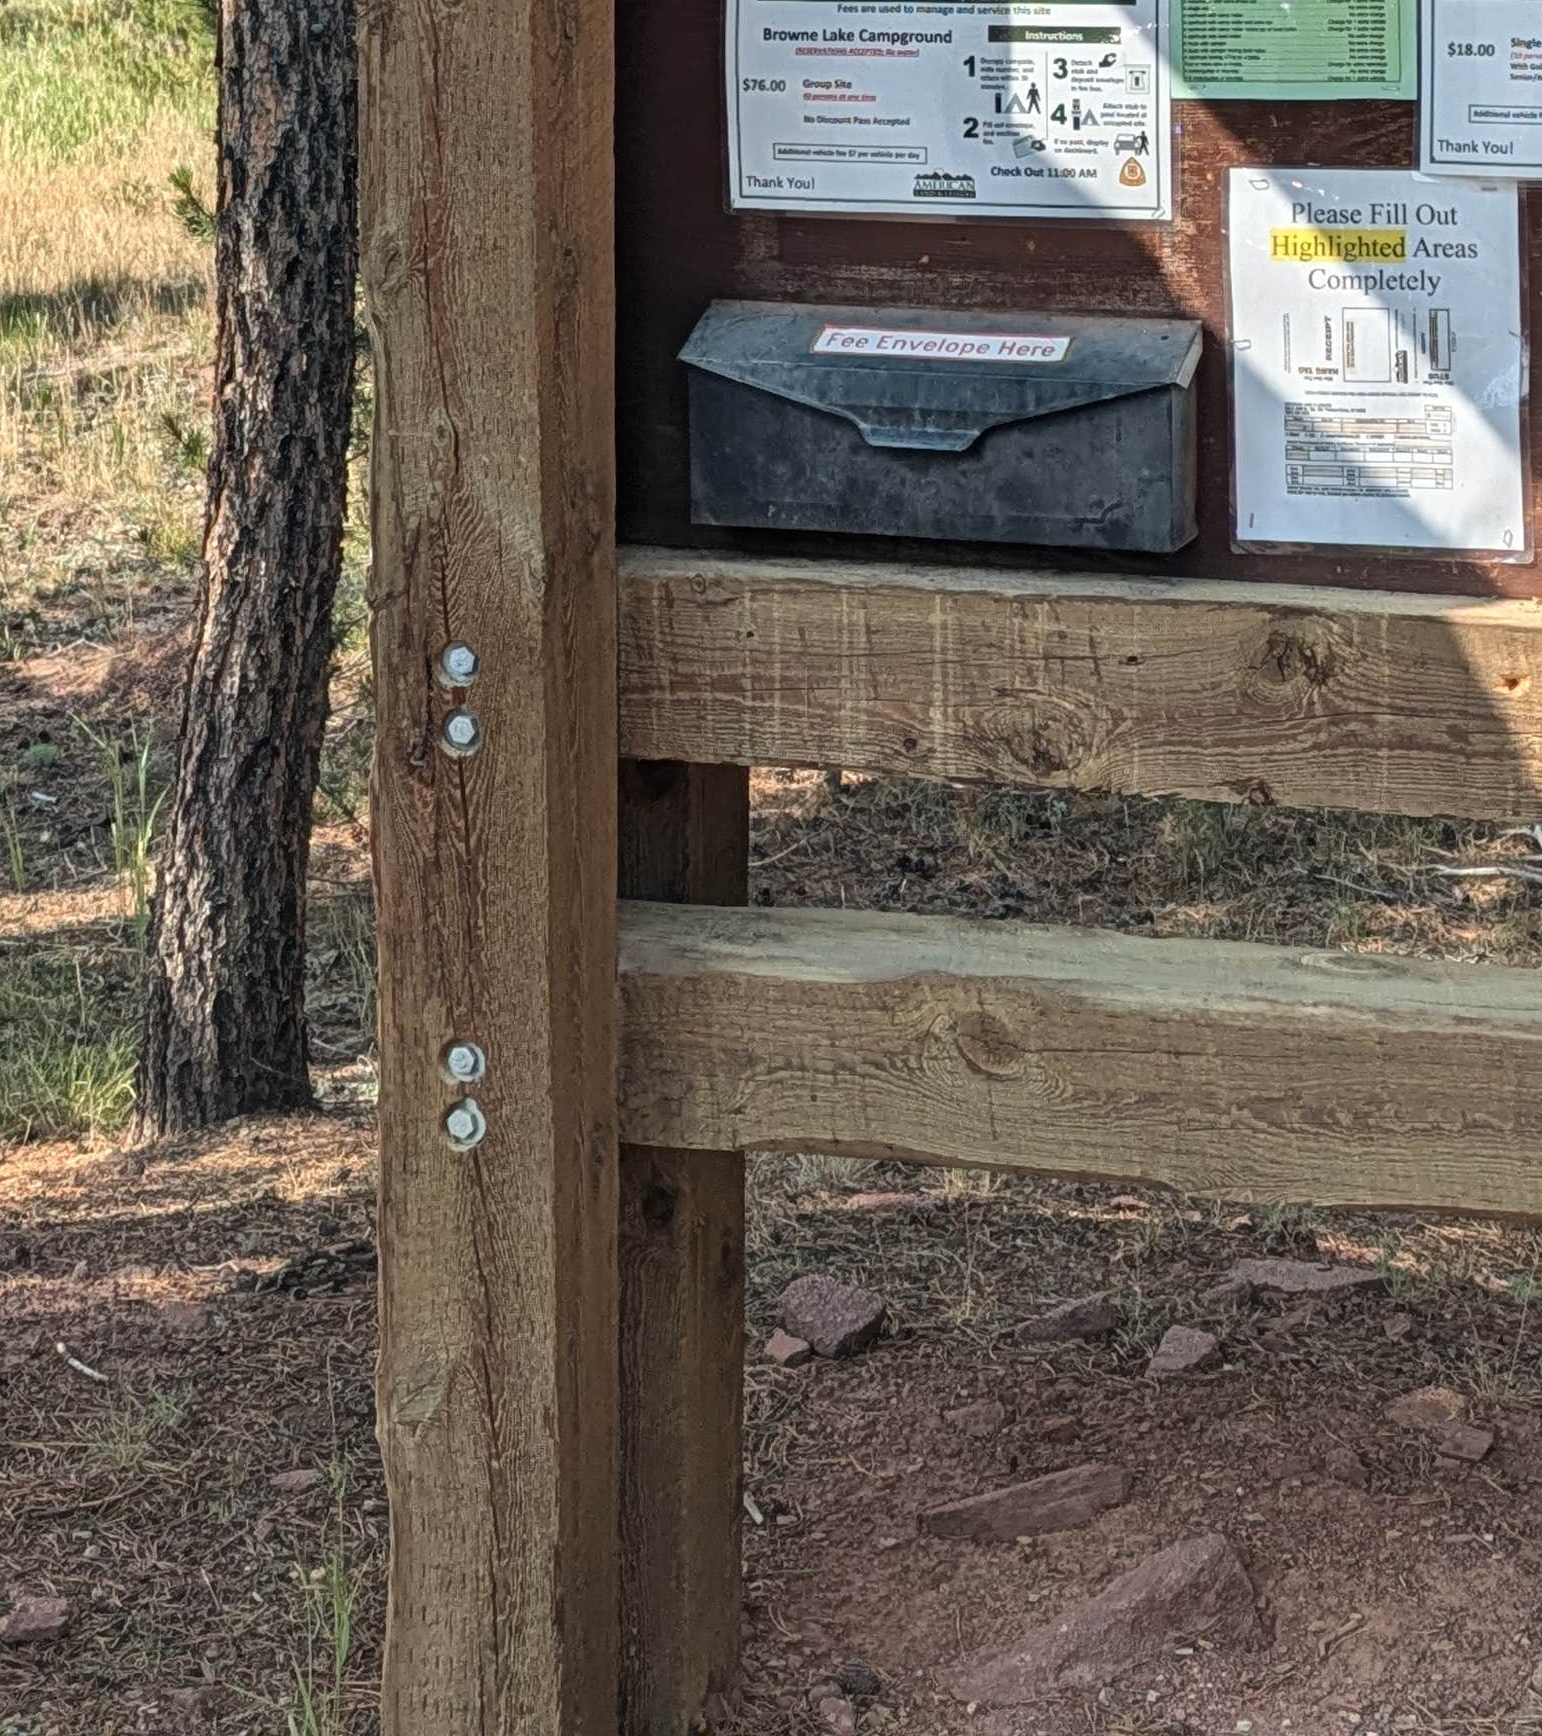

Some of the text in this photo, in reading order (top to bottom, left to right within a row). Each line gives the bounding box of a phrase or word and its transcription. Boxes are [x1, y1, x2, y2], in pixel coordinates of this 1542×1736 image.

[837, 4, 1051, 16] Fees are used to manage and service this site
[763, 28, 952, 46] Browne Lake Campground
[1025, 30, 1083, 42] Instructions
[1510, 38, 1542, 49] Single
[1447, 42, 1495, 57] $18.00
[963, 55, 975, 77] 1
[1053, 57, 1068, 79] 3
[743, 78, 852, 92] $76.00 Group Site
[1051, 103, 1067, 125] 4
[963, 117, 979, 138] 2
[1438, 140, 1513, 154] Thank You!
[991, 166, 1097, 179] Check Out 11:00 AM
[746, 176, 815, 190] Thank You!
[1291, 202, 1457, 226] Please Fill Out
[1271, 234, 1478, 262] Highlighted Areas
[1308, 268, 1441, 296] Completely
[825, 331, 1055, 358] Fee Envelope Here
